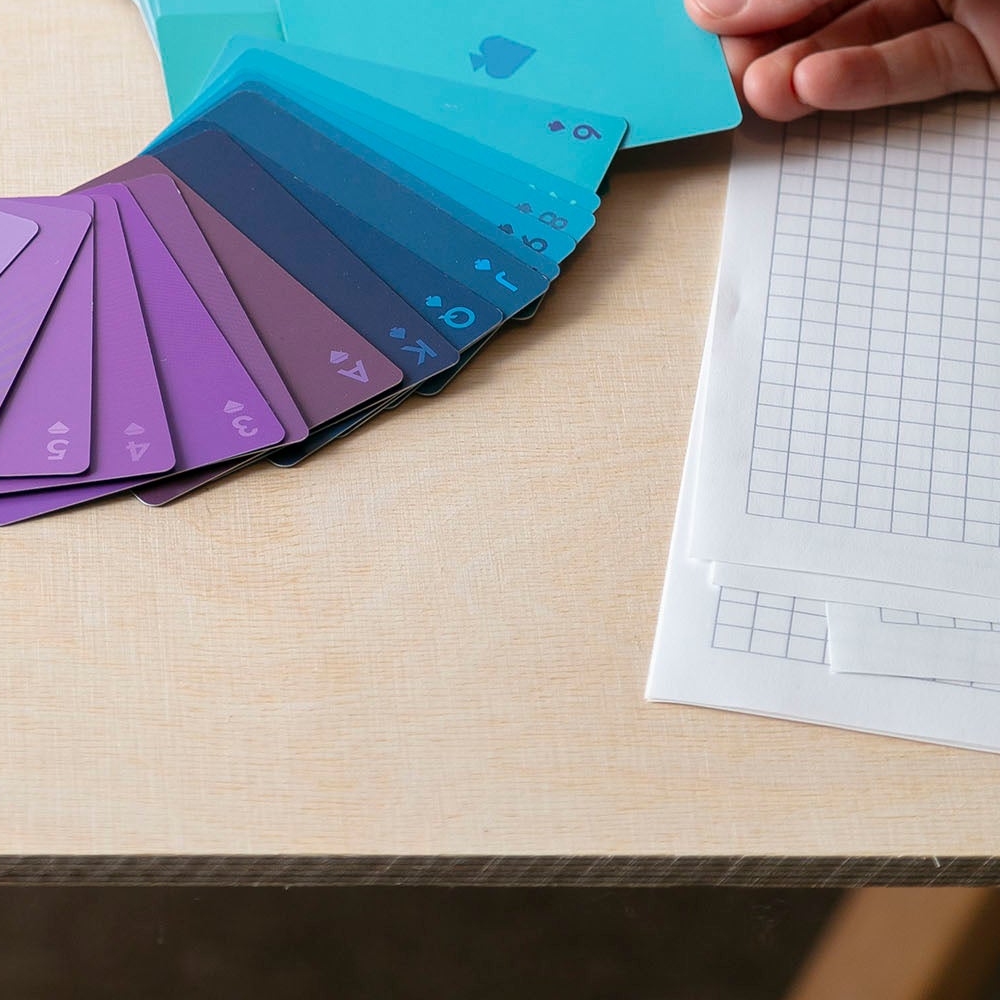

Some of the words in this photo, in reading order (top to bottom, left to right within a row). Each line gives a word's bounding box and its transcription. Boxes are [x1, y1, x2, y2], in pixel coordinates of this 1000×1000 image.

[572, 124, 602, 140] 6
[538, 210, 568, 230] 8
[522, 235, 548, 253] 9
[495, 270, 519, 293] J
[437, 306, 476, 329] Q
[401, 339, 437, 366] K
[337, 358, 370, 384] A
[231, 415, 258, 438] 3
[46, 439, 70, 461] 5
[125, 440, 151, 462] 4
